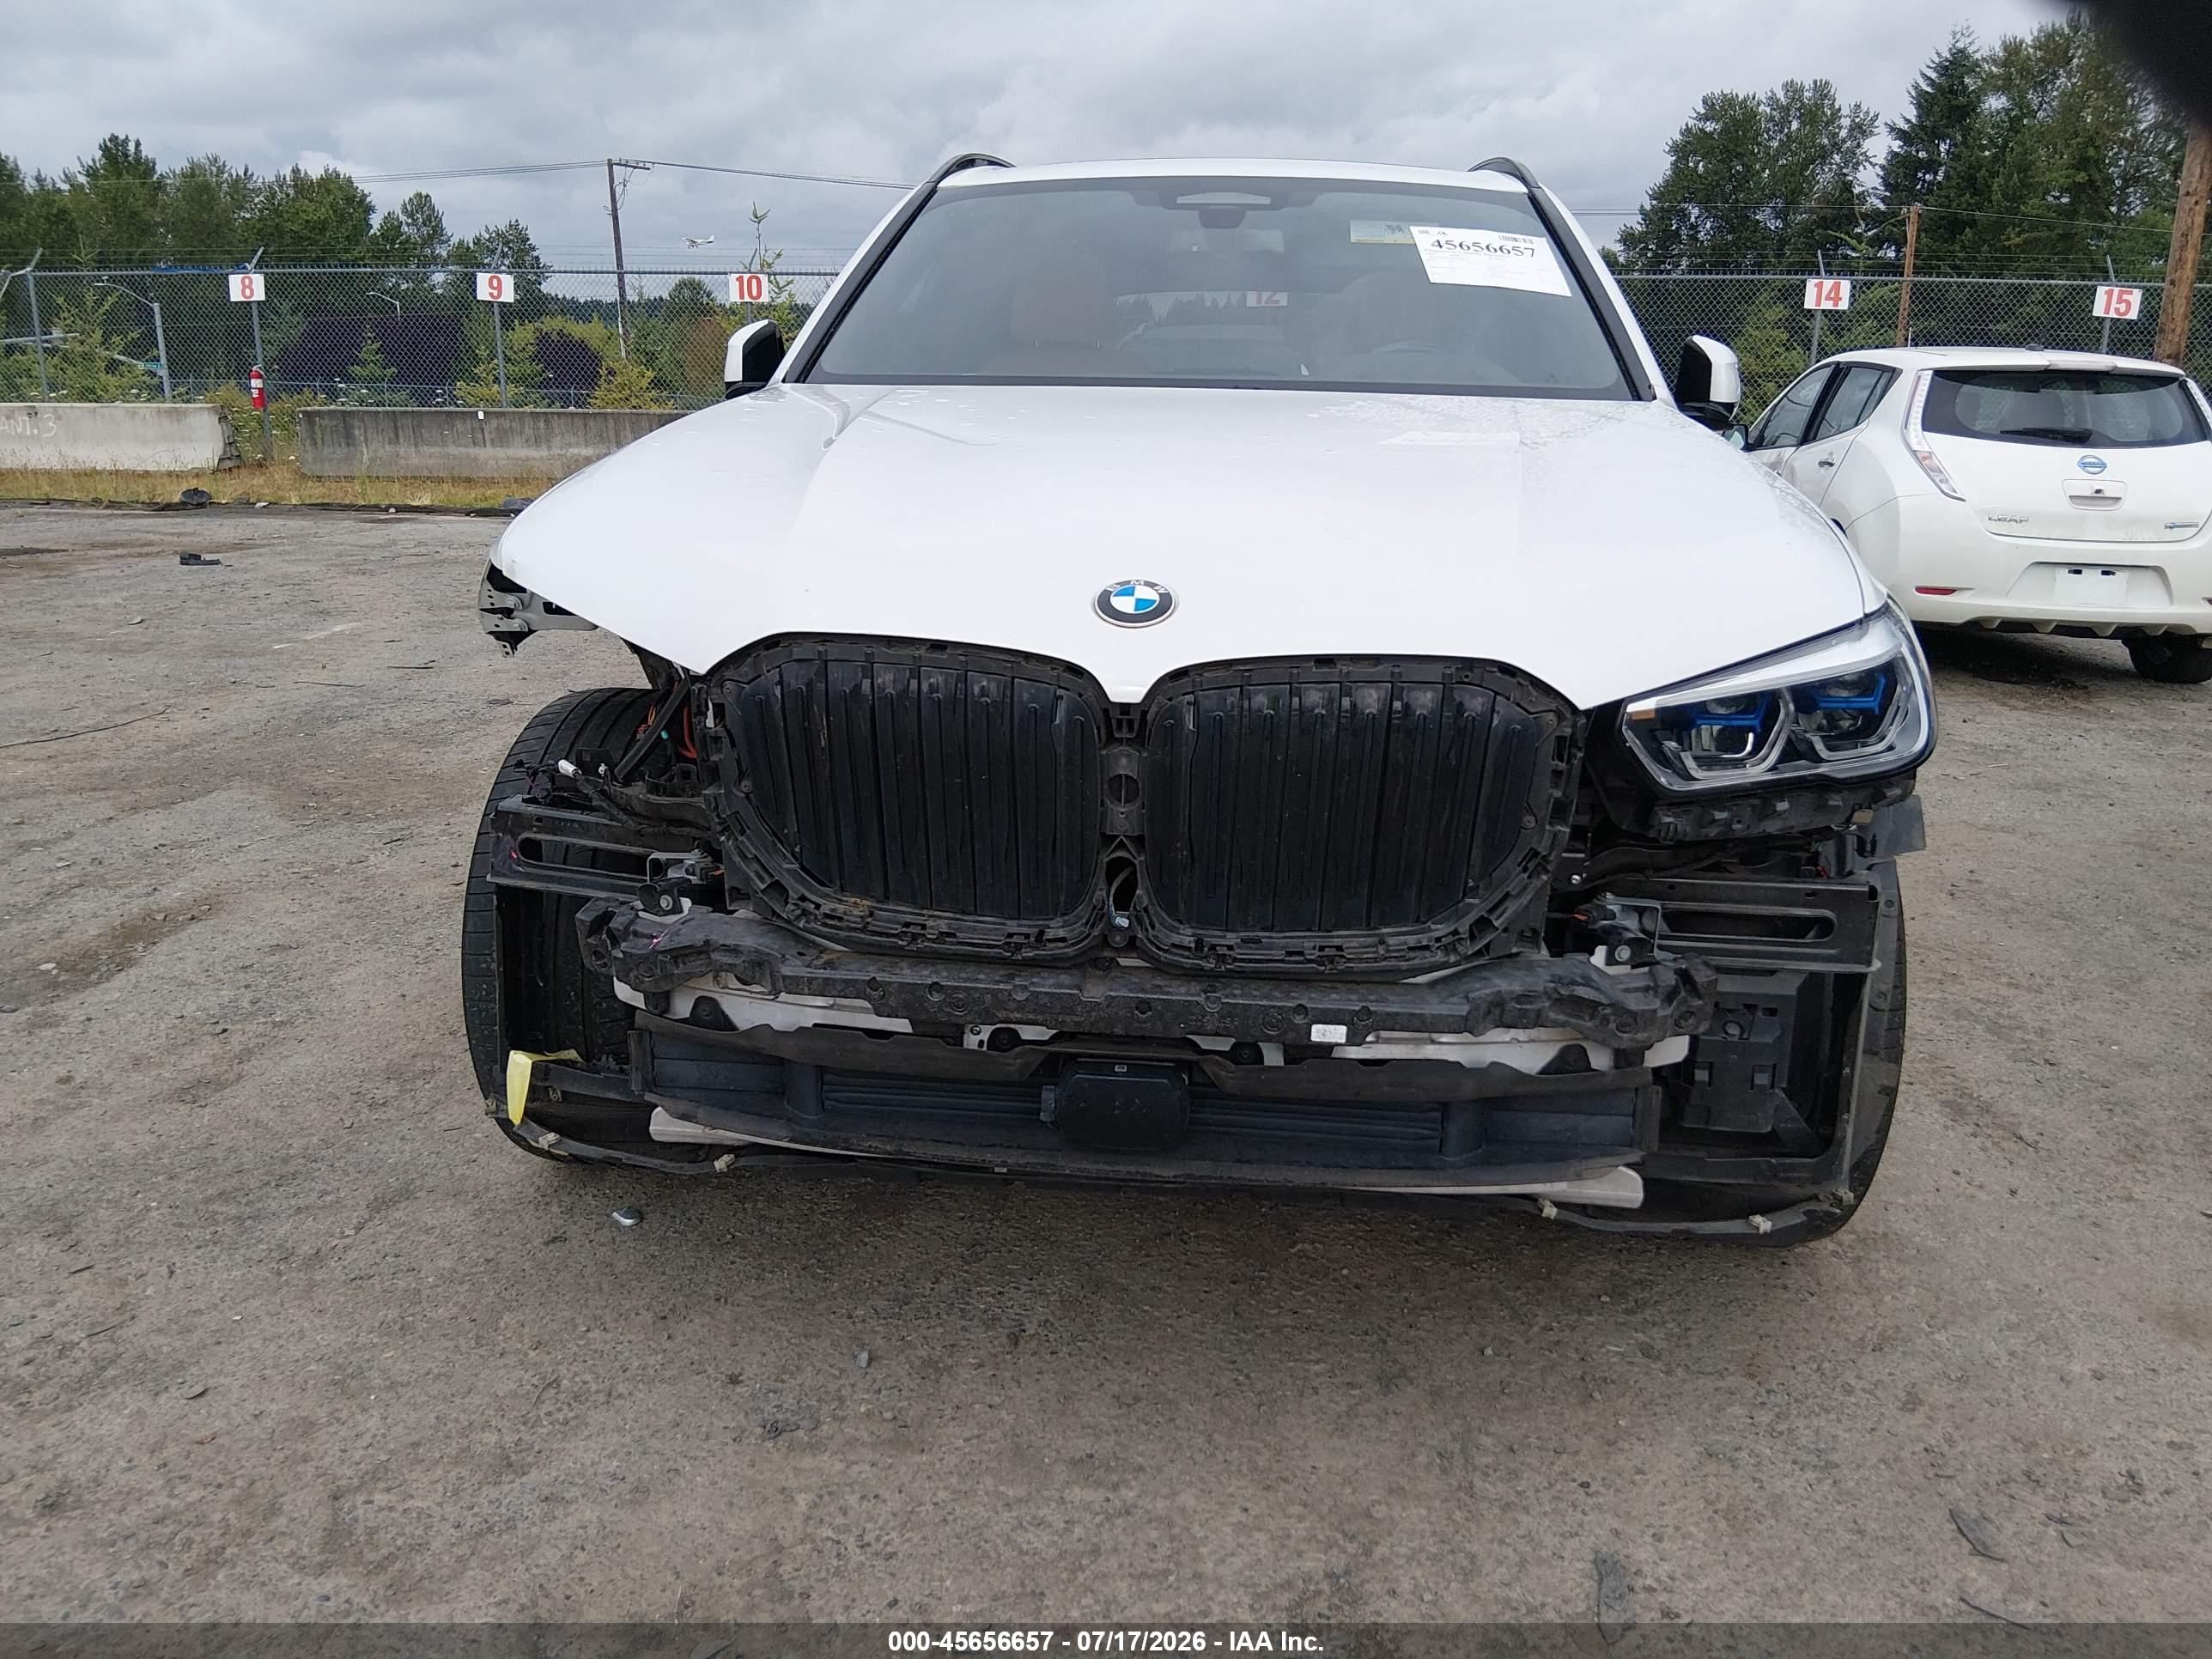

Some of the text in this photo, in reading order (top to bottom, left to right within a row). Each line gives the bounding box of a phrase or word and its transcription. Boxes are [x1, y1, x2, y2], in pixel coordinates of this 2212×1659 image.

[1431, 239, 1534, 258] 45656657
[240, 275, 254, 299] 8
[488, 275, 502, 300] 9
[736, 275, 762, 301] 10
[1814, 280, 1842, 307] 14
[2103, 288, 2133, 317] 15
[1105, 580, 1169, 593] BMW
